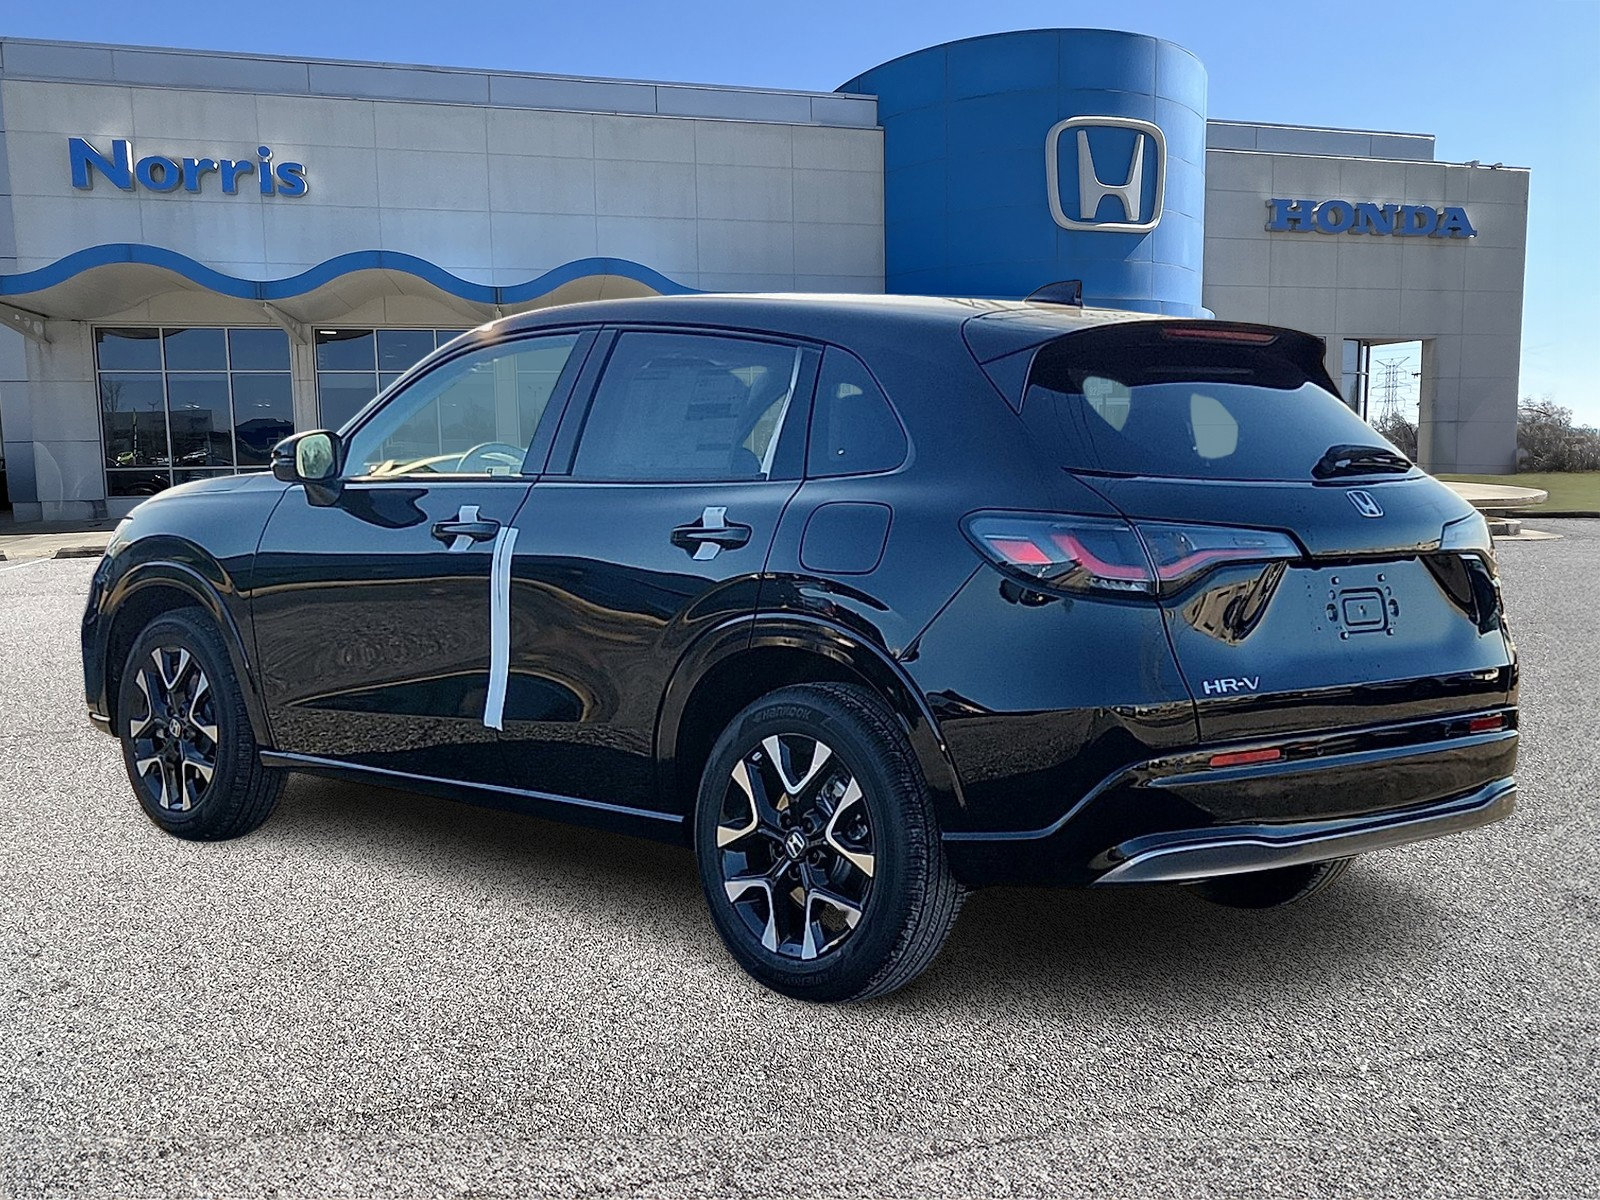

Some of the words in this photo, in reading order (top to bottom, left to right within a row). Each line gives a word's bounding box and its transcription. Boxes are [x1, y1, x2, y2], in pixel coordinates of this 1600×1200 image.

[68, 136, 309, 197] Norris
[1266, 198, 1477, 239] HONDA
[1203, 676, 1259, 695] HR-V
